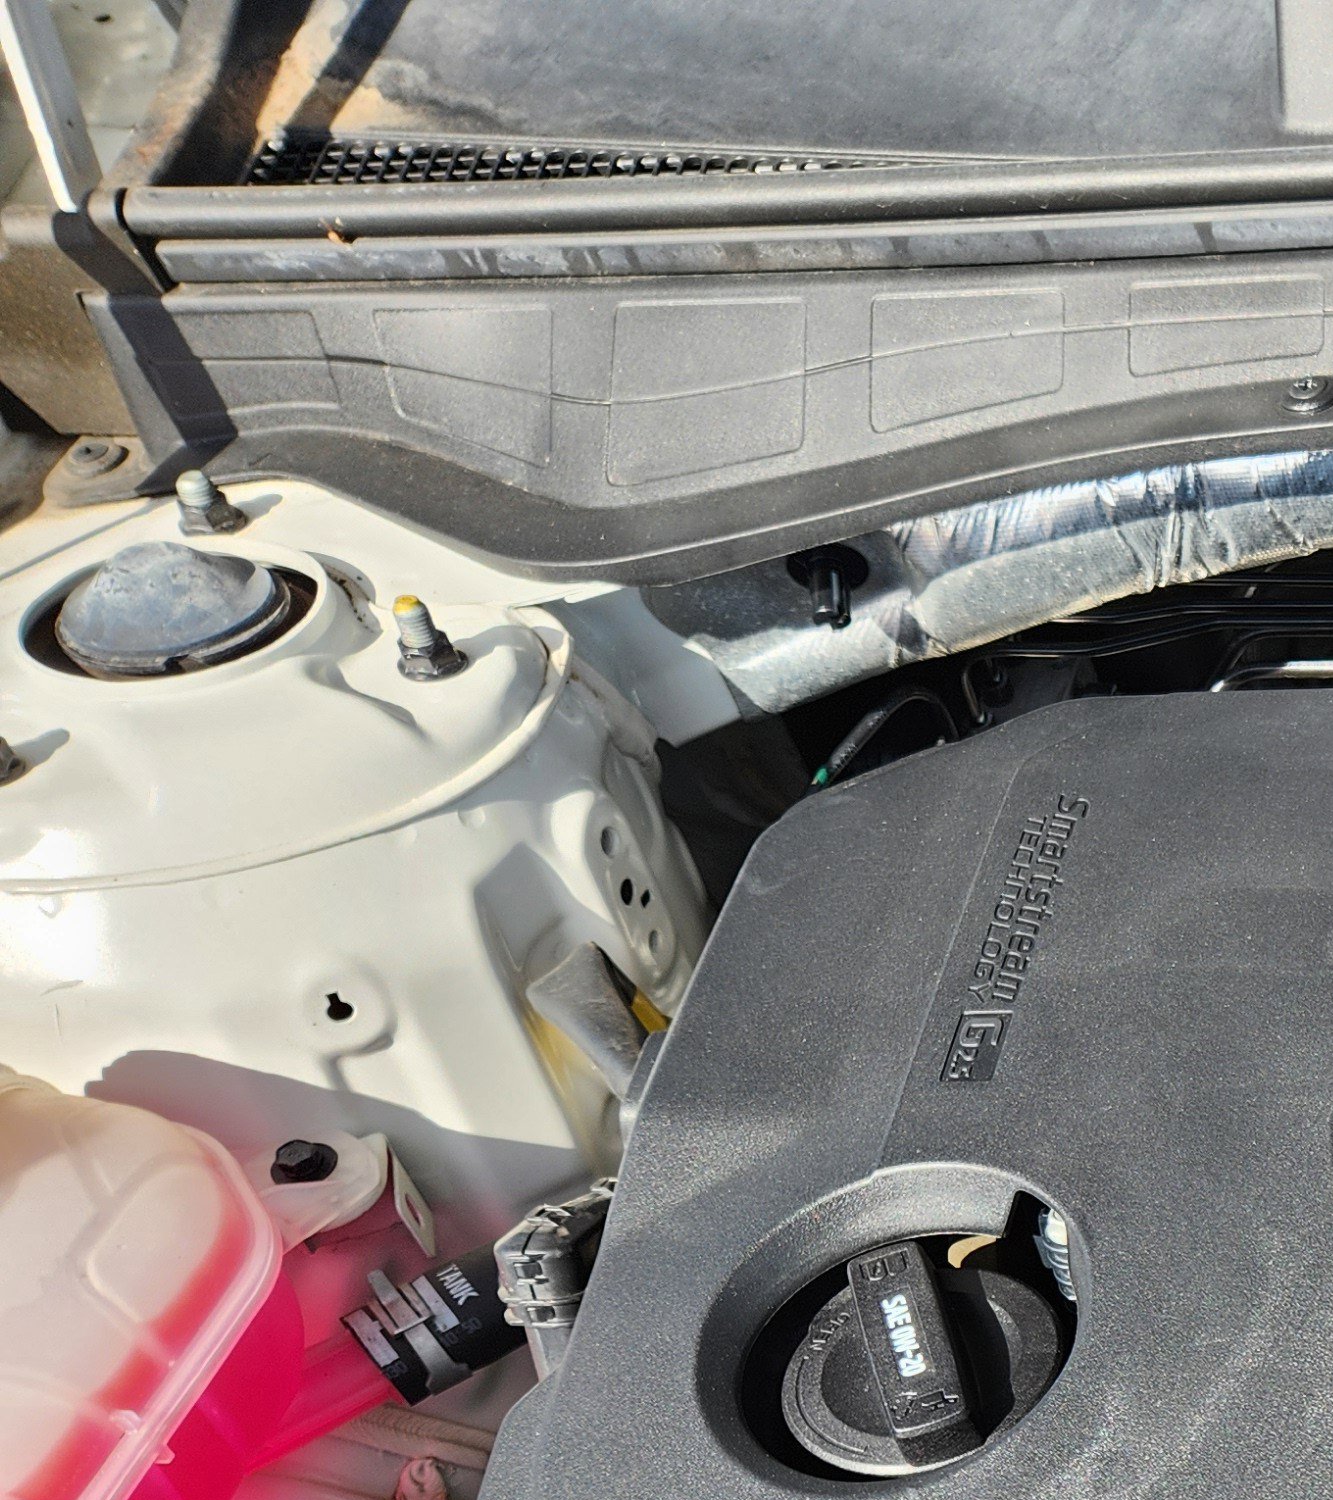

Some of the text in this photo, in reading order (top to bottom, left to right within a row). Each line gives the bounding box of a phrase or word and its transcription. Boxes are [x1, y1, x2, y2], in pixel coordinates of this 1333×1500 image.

[968, 815, 1048, 1004] TECHNOLOGY
[993, 795, 1091, 1002] Smartstream
[436, 1264, 480, 1306] TANK
[880, 1294, 927, 1378] SAE 0W-20
